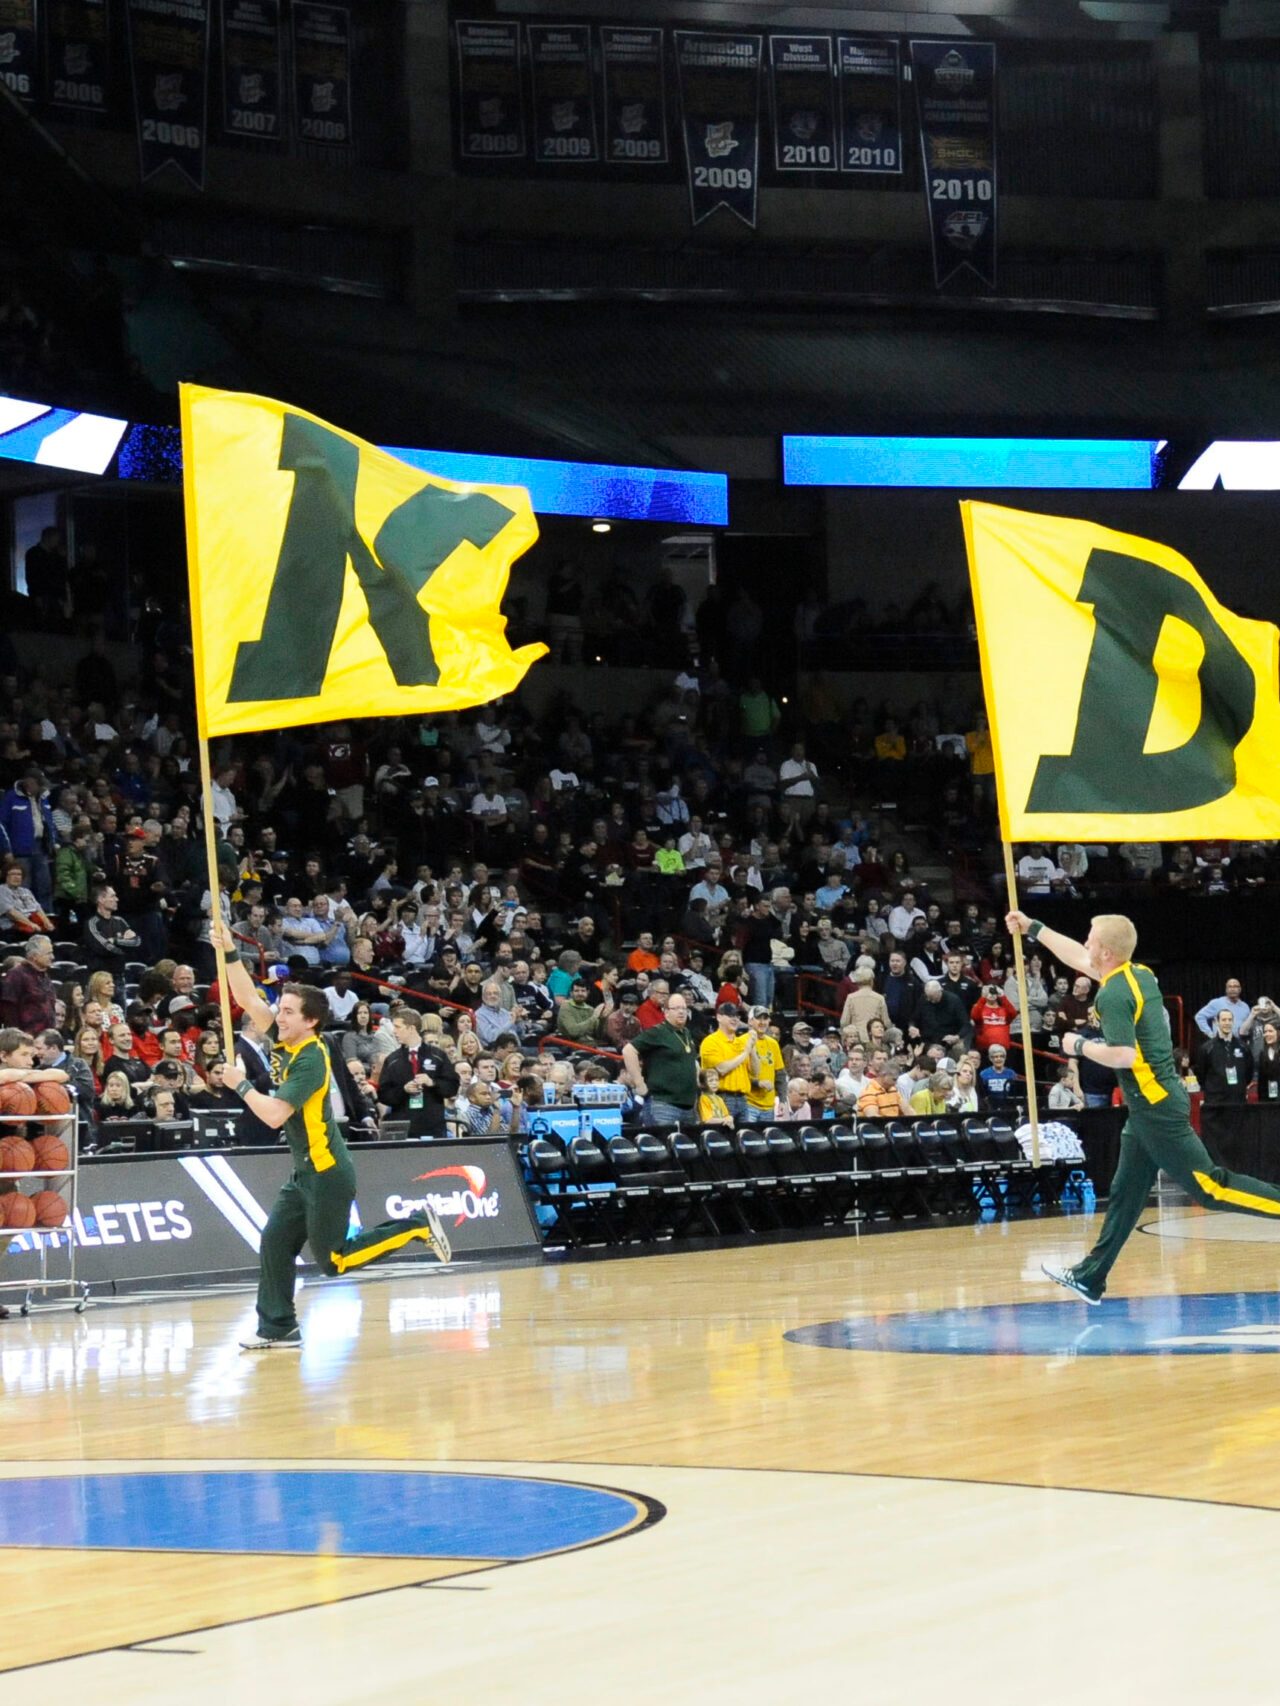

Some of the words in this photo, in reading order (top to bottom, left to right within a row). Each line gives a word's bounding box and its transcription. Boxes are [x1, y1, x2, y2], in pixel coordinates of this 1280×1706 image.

[53, 79, 103, 102] 2006
[231, 108, 276, 133] 2007
[142, 117, 200, 149] 2006
[543, 137, 591, 156] 2009
[612, 138, 661, 157] 2009
[783, 145, 830, 164] 2010
[848, 147, 896, 166] 2010
[694, 166, 753, 189] 2009
[932, 178, 992, 200] 2010
[1024, 547, 1256, 814] D
